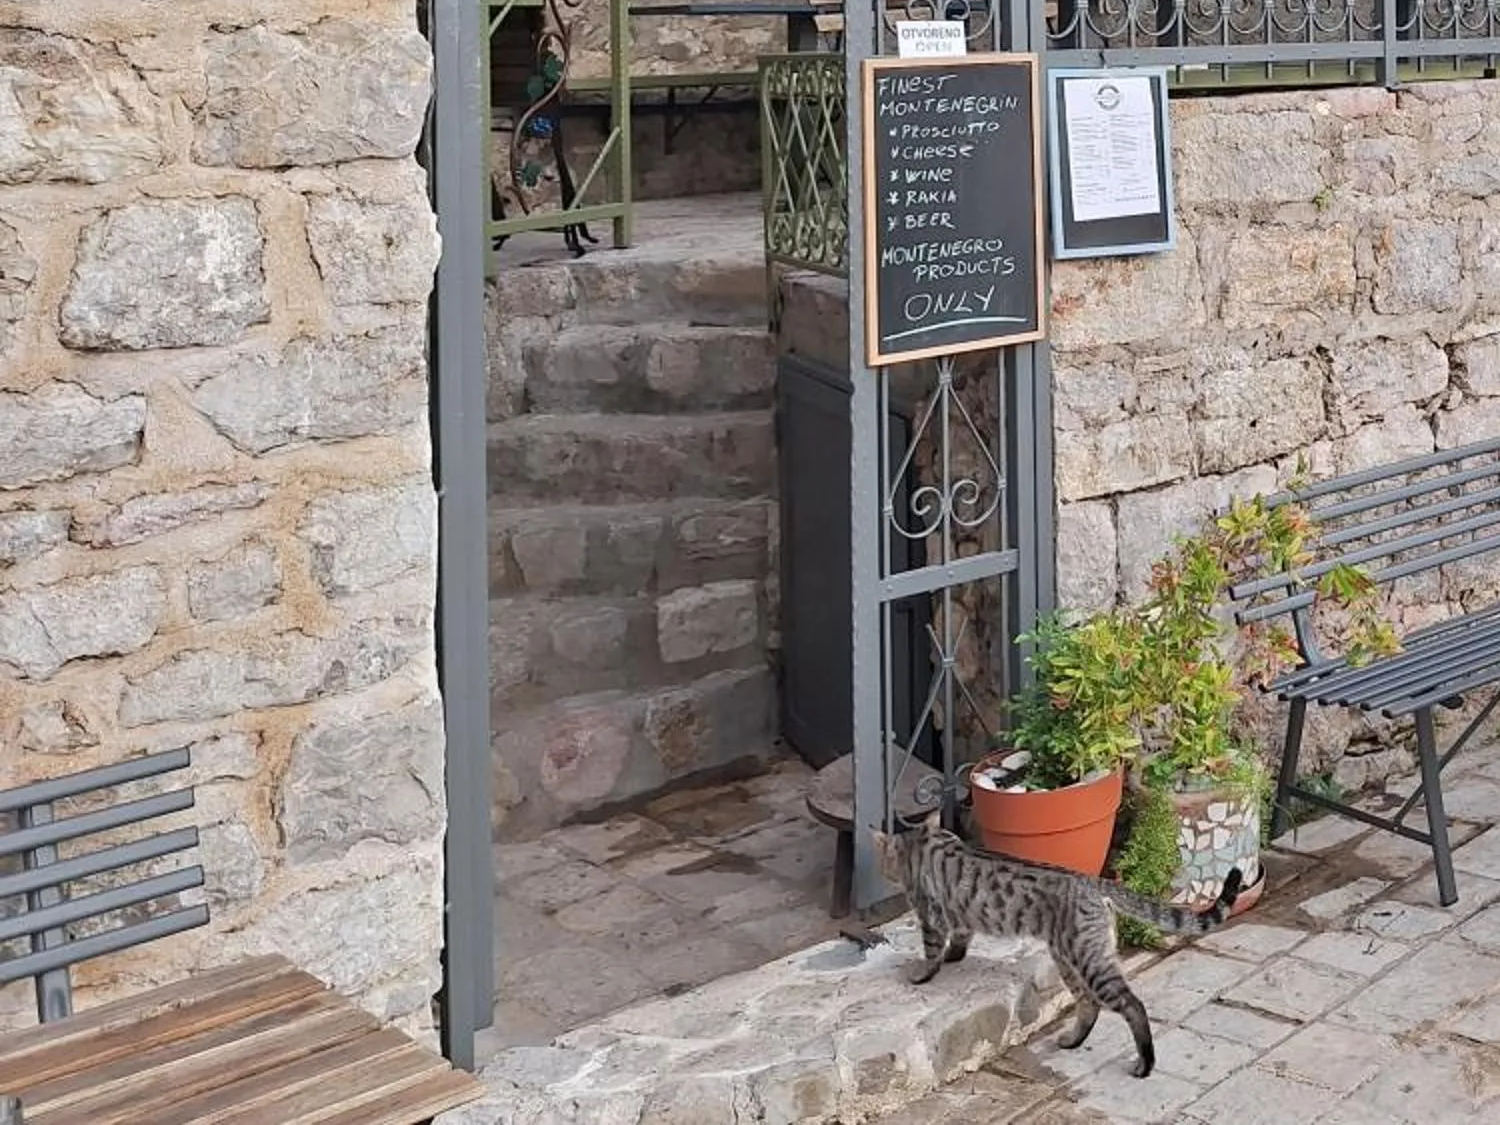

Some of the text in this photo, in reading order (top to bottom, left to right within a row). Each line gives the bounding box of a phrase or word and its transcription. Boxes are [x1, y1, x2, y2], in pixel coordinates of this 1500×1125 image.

[901, 122, 1000, 139] PROSCIUTTO
[905, 190, 957, 207] RAKIA
[904, 212, 956, 229] BEER
[881, 238, 1003, 268] MONTENEGRO
[913, 256, 1015, 283] PRODUCTS
[904, 284, 995, 322] ONLY
